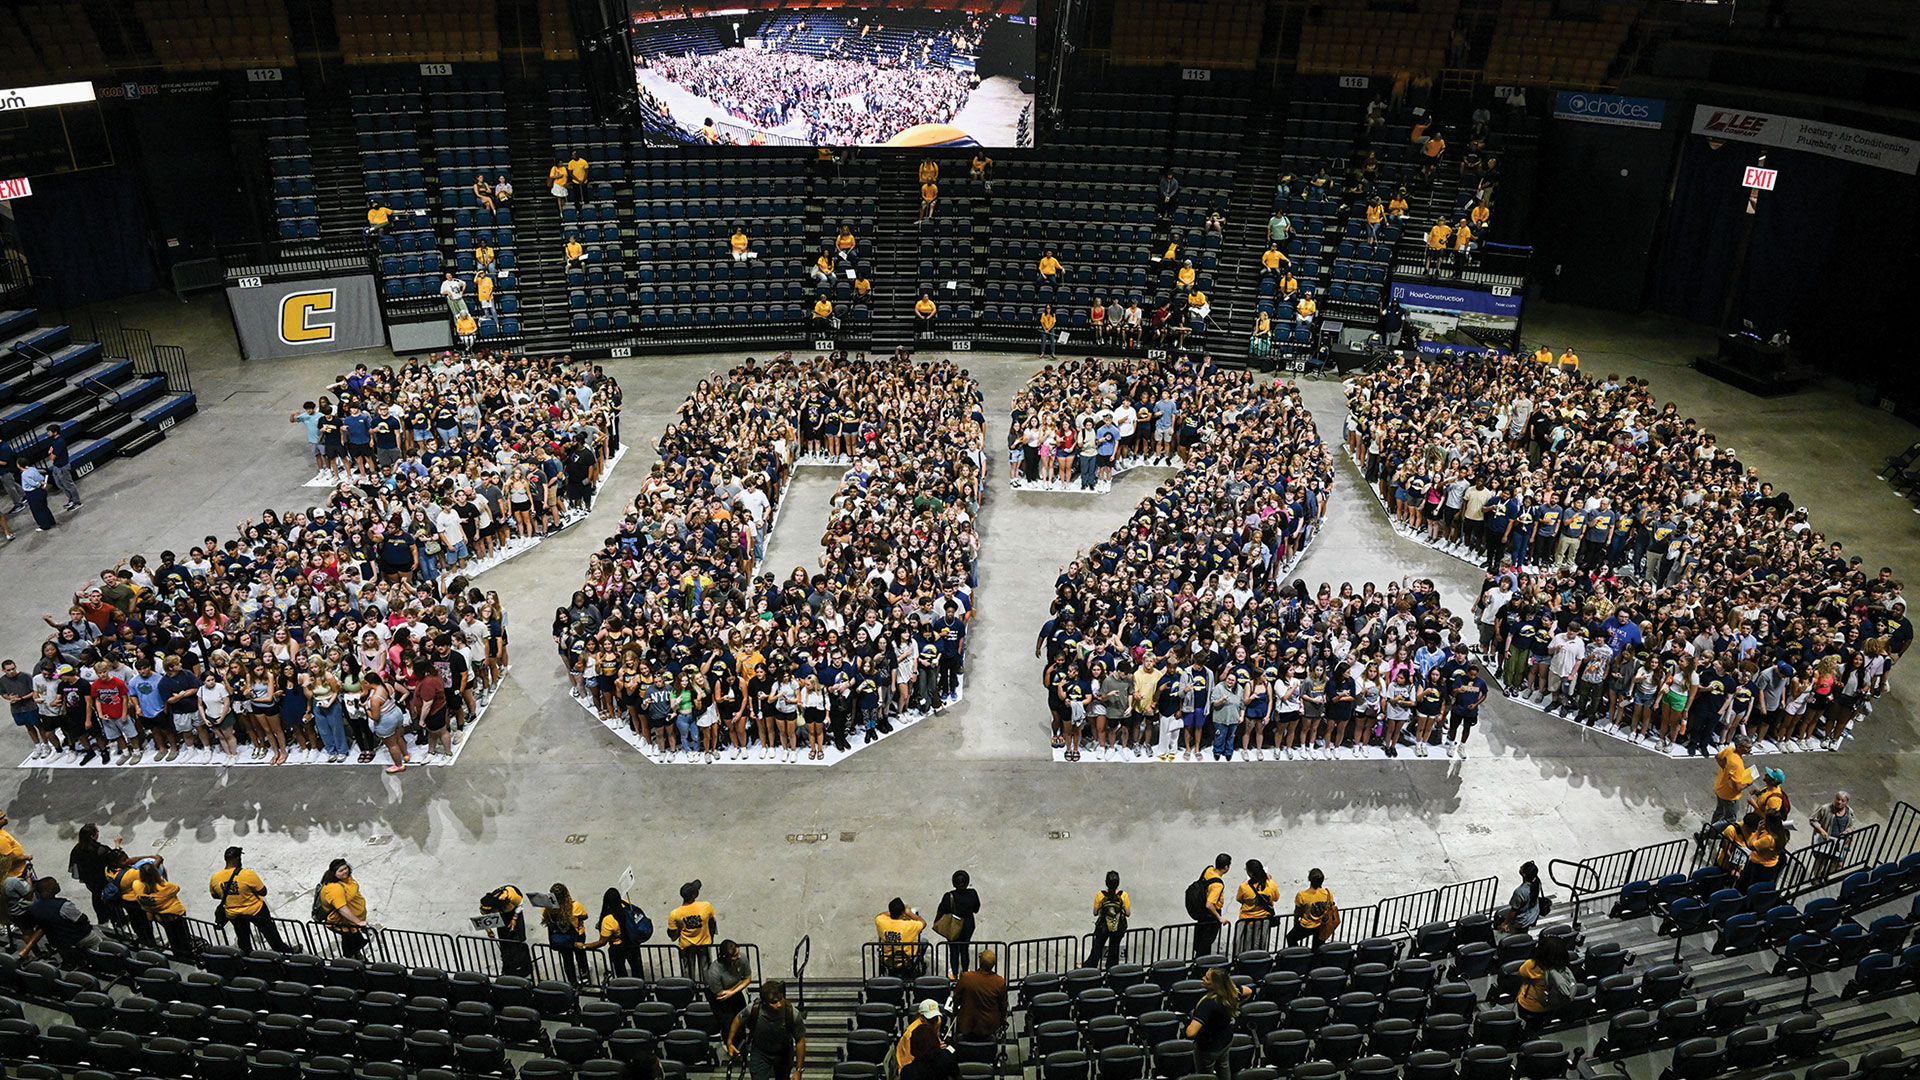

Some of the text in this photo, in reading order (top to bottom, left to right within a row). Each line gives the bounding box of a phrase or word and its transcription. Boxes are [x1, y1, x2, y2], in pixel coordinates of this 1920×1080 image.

[254, 70, 276, 79] 112
[426, 65, 446, 74] 113
[1188, 70, 1205, 79] 115
[1345, 79, 1362, 87] 116
[1588, 97, 1649, 118] choices
[1728, 114, 1768, 133] LEE
[1724, 128, 1758, 138] COMPANY
[1800, 124, 1910, 154] Heating Air Conditioning
[1797, 136, 1882, 161] Plumbing Electrical
[1745, 169, 1776, 189] EXIT
[0, 178, 27, 198] EXIT
[240, 278, 259, 287] 112
[1494, 287, 1510, 295] 117
[278, 288, 337, 345] C
[613, 348, 628, 356] 114
